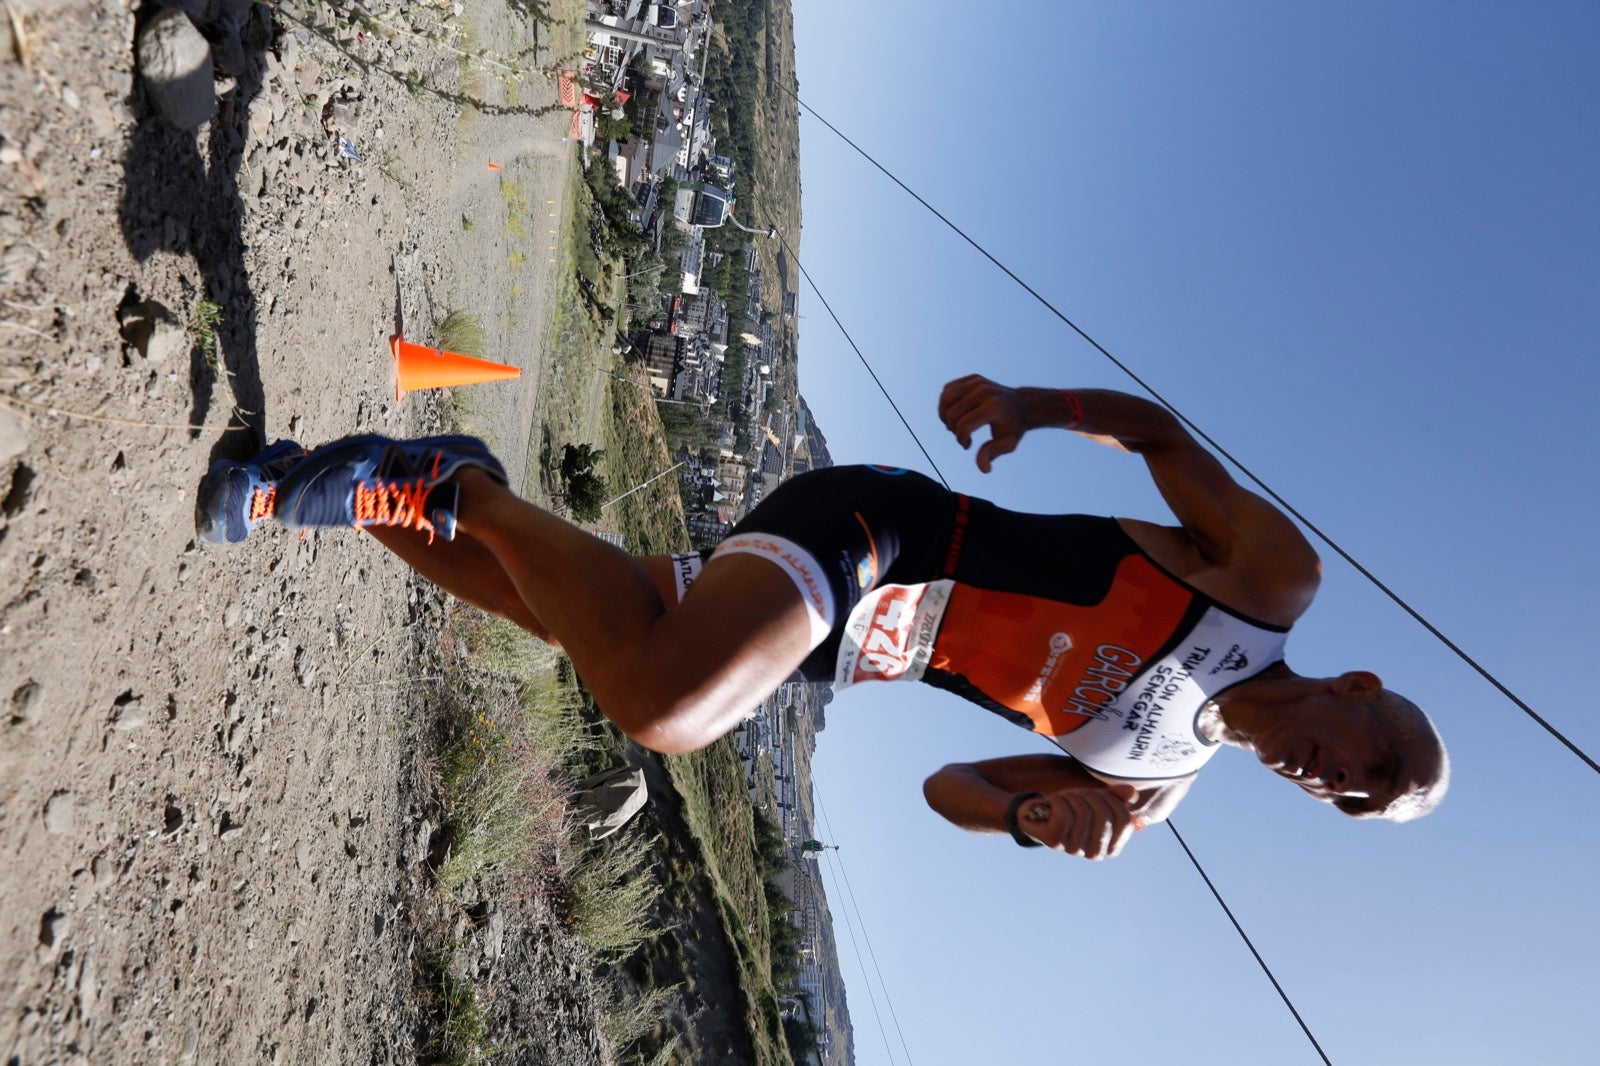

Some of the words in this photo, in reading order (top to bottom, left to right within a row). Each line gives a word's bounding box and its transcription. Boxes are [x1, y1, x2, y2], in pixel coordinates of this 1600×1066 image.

[860, 599, 915, 675] 426
[1061, 644, 1142, 721] GARCÍA
[1122, 665, 1172, 731] SENEGAR
[1158, 645, 1210, 702] TRIATLÓN
[1126, 703, 1165, 761] ALHAURIN
